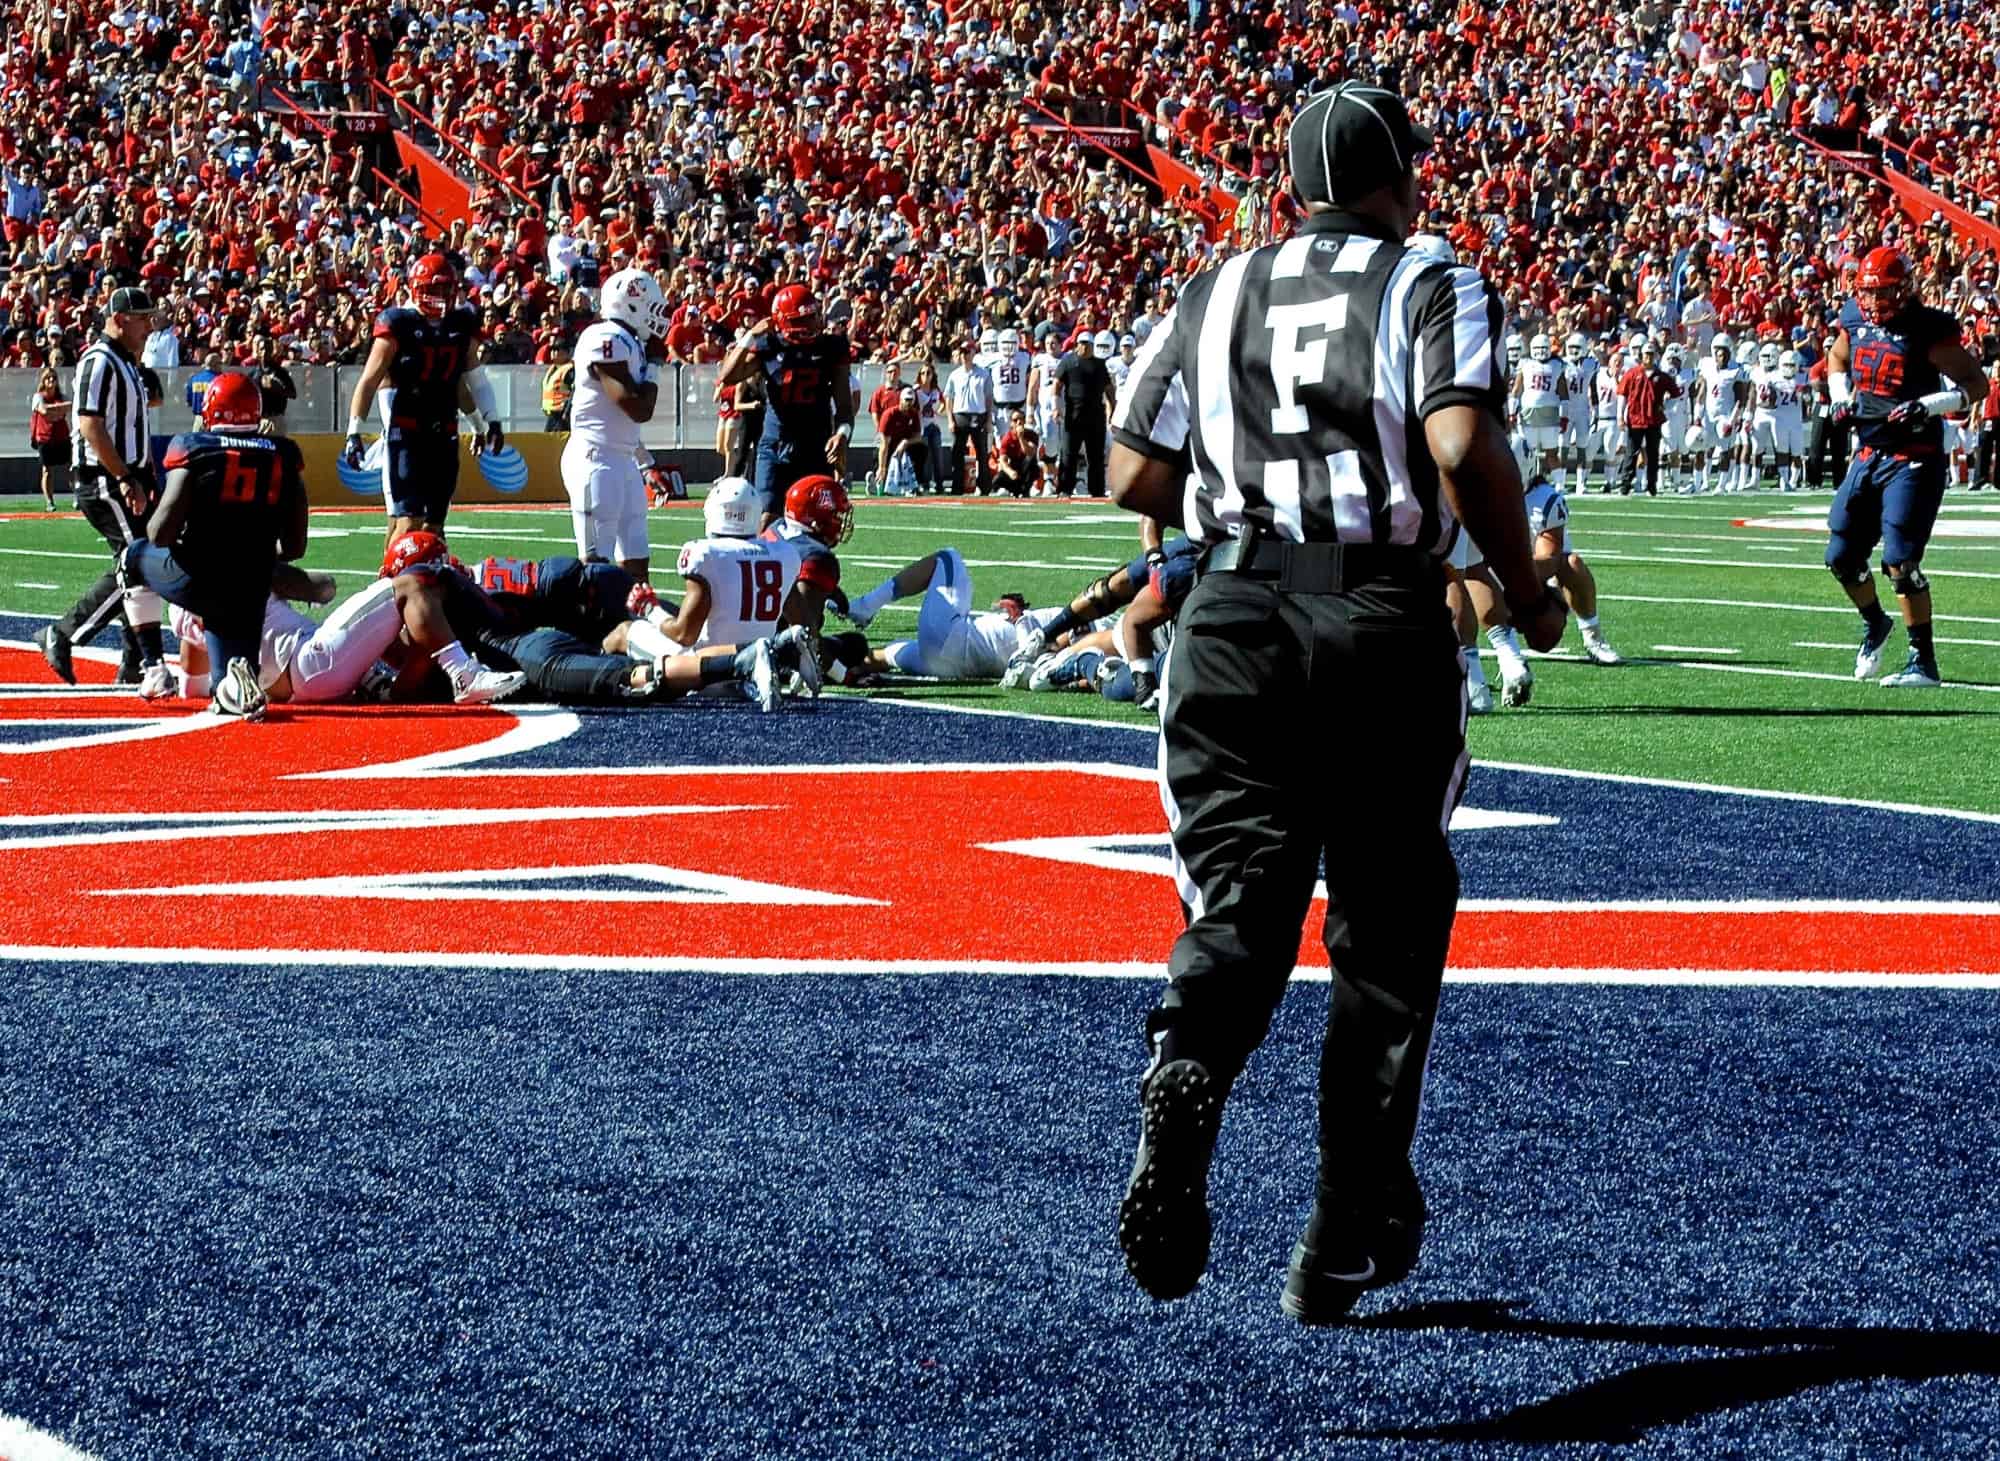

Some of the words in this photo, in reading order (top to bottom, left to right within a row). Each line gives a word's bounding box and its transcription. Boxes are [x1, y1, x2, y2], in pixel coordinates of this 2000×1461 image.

[355, 120, 366, 130] 20
[420, 346, 458, 380] 17
[1264, 293, 1349, 434] F
[1000, 367, 1020, 385] 56
[1531, 375, 1552, 392] 95
[1569, 376, 1584, 394] 41
[1711, 383, 1720, 398] 4
[1780, 391, 1799, 405] 24
[221, 449, 283, 504] 61
[736, 560, 782, 622] 18
